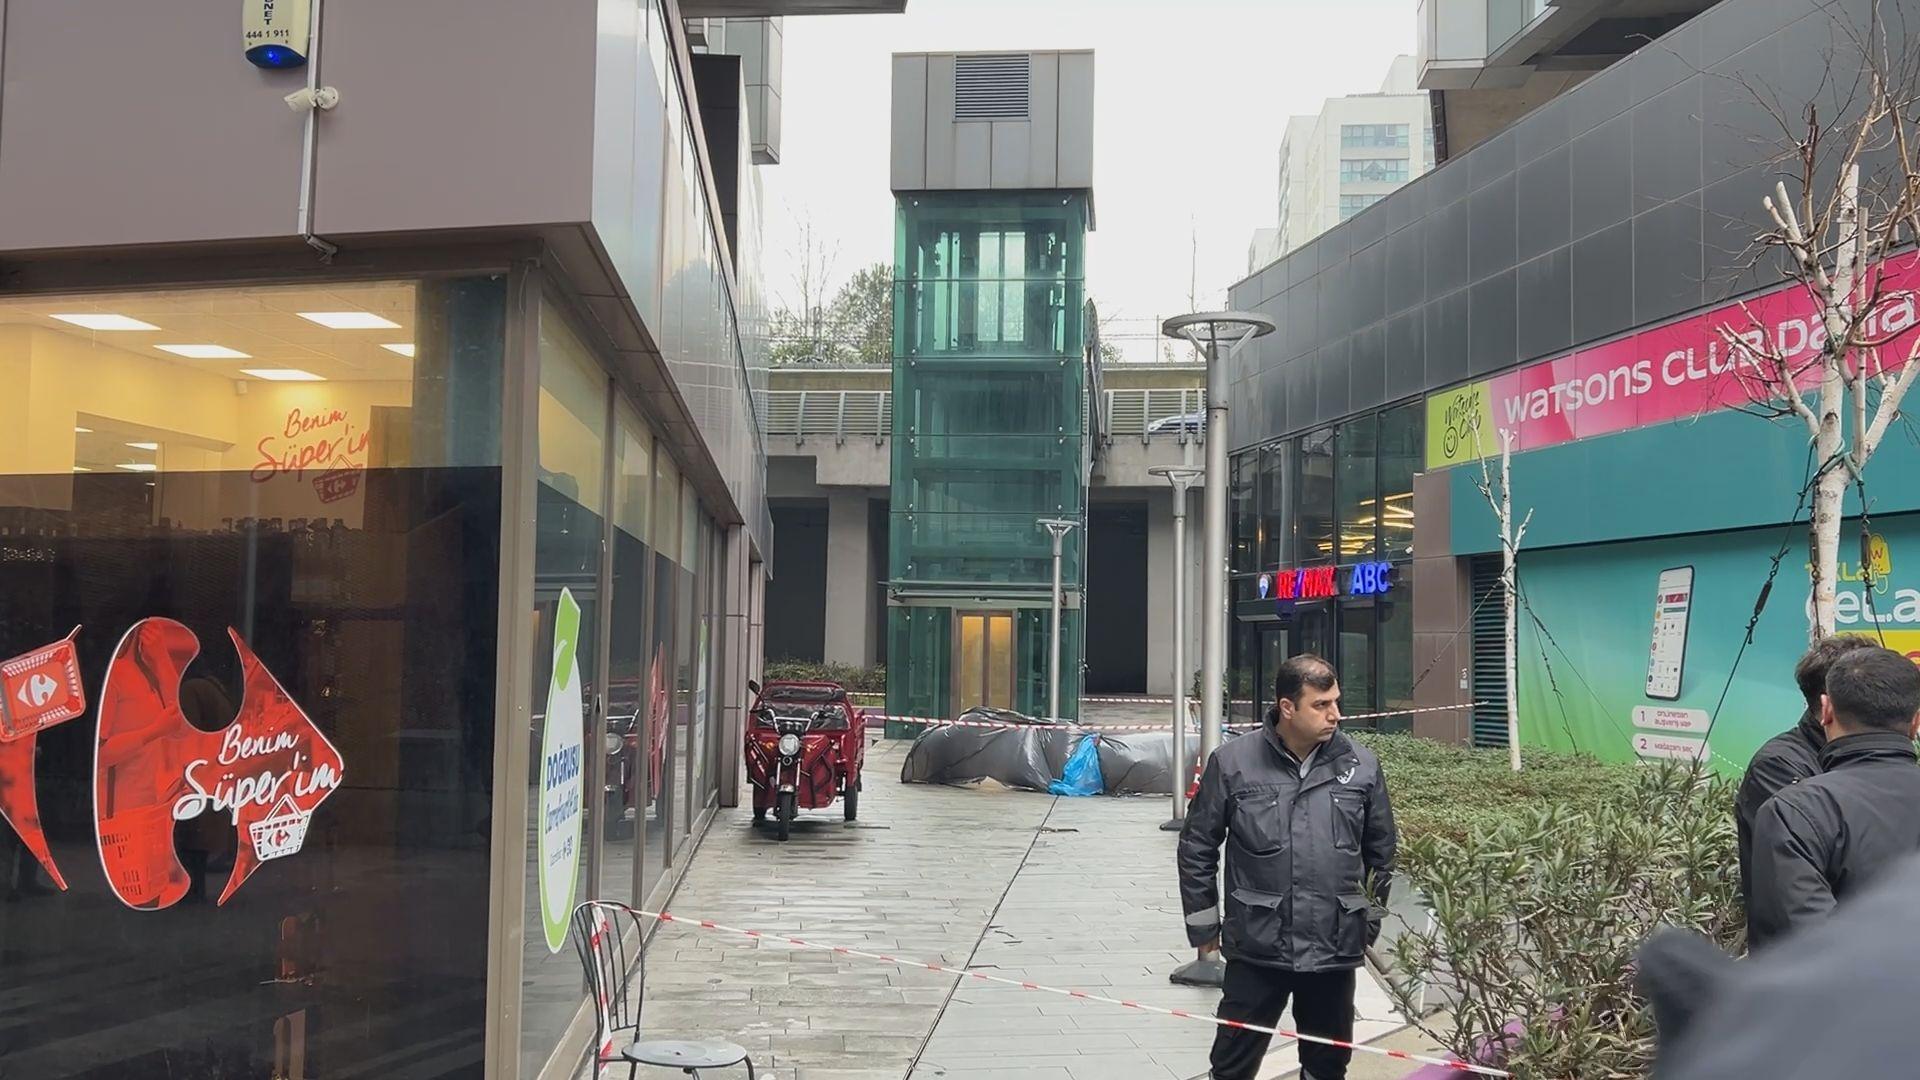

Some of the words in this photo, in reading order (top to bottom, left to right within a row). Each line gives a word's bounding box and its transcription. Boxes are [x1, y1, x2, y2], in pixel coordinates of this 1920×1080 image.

[266, 30, 270, 38] 1
[273, 29, 289, 37] 911
[284, 408, 347, 438] Benim
[1350, 561, 1390, 596] ABC
[218, 723, 300, 766] Benim
[1640, 738, 1648, 750] 2
[172, 751, 343, 827] Süper'im
